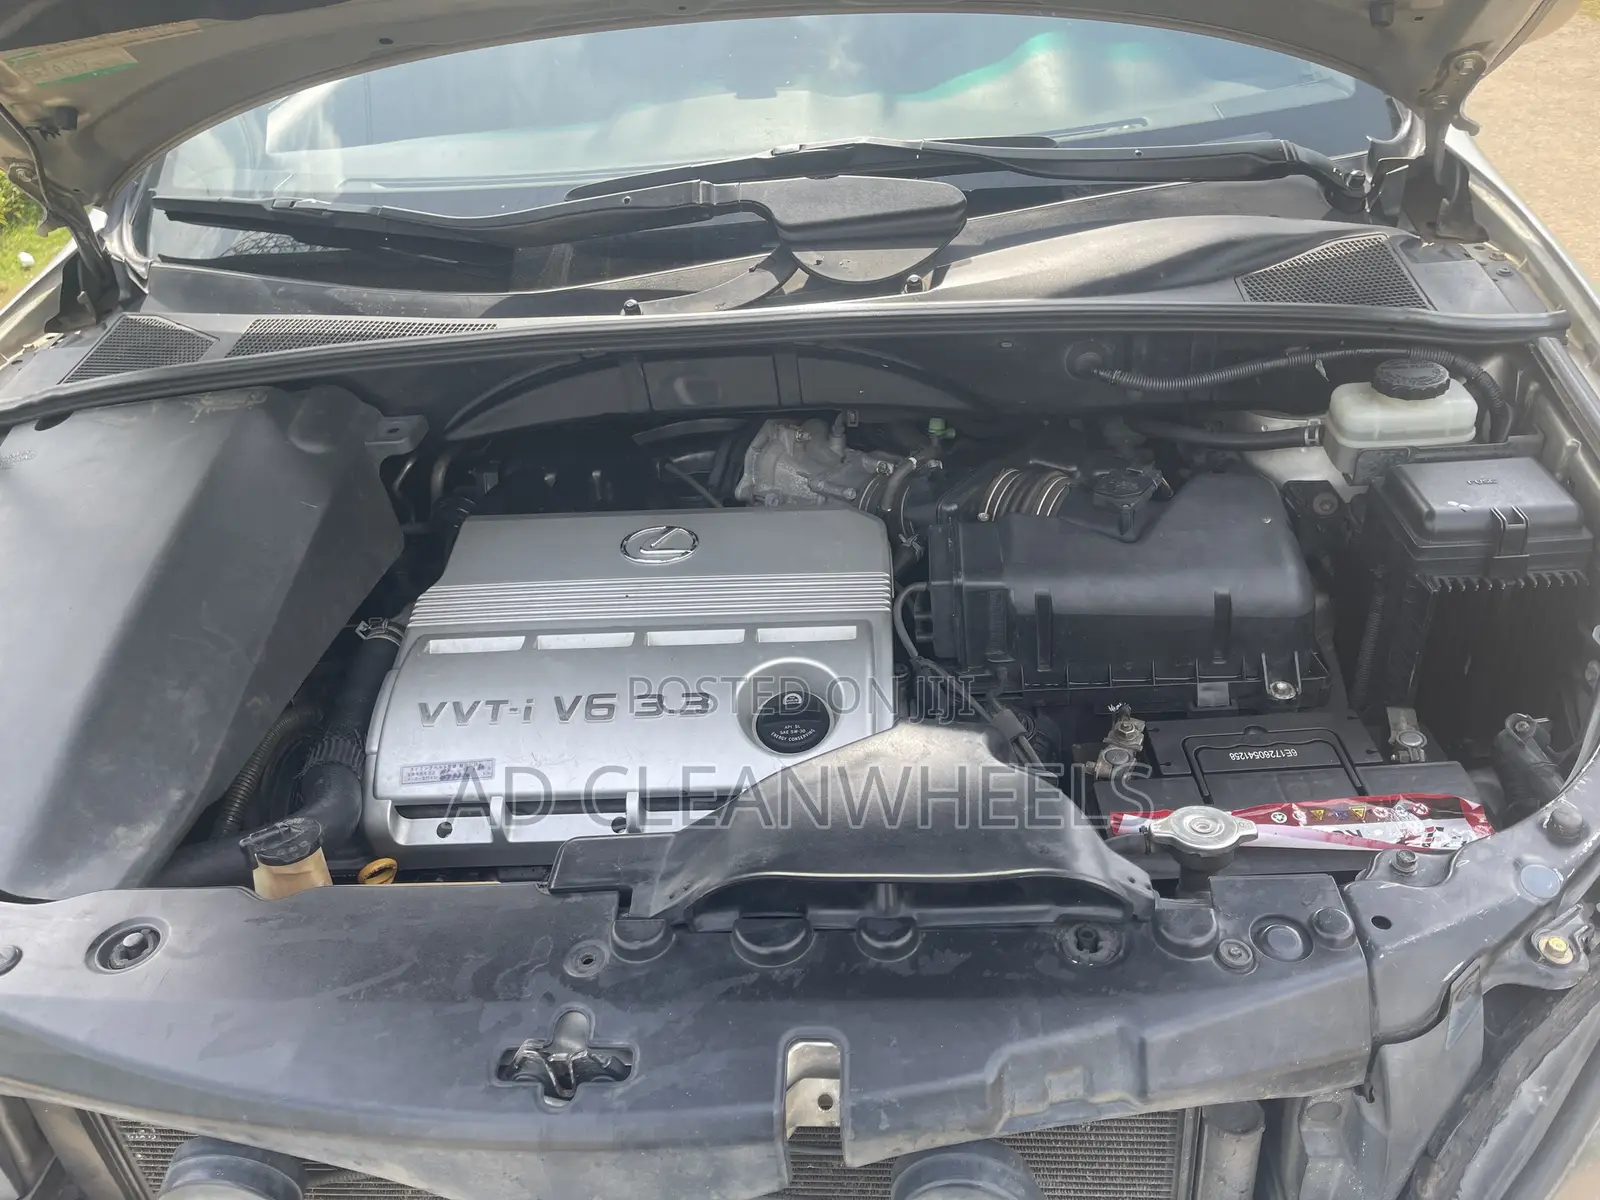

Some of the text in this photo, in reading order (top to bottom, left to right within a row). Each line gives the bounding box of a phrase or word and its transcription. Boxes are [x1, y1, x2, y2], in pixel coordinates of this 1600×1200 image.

[418, 692, 713, 727] VVT-i V6 3.3
